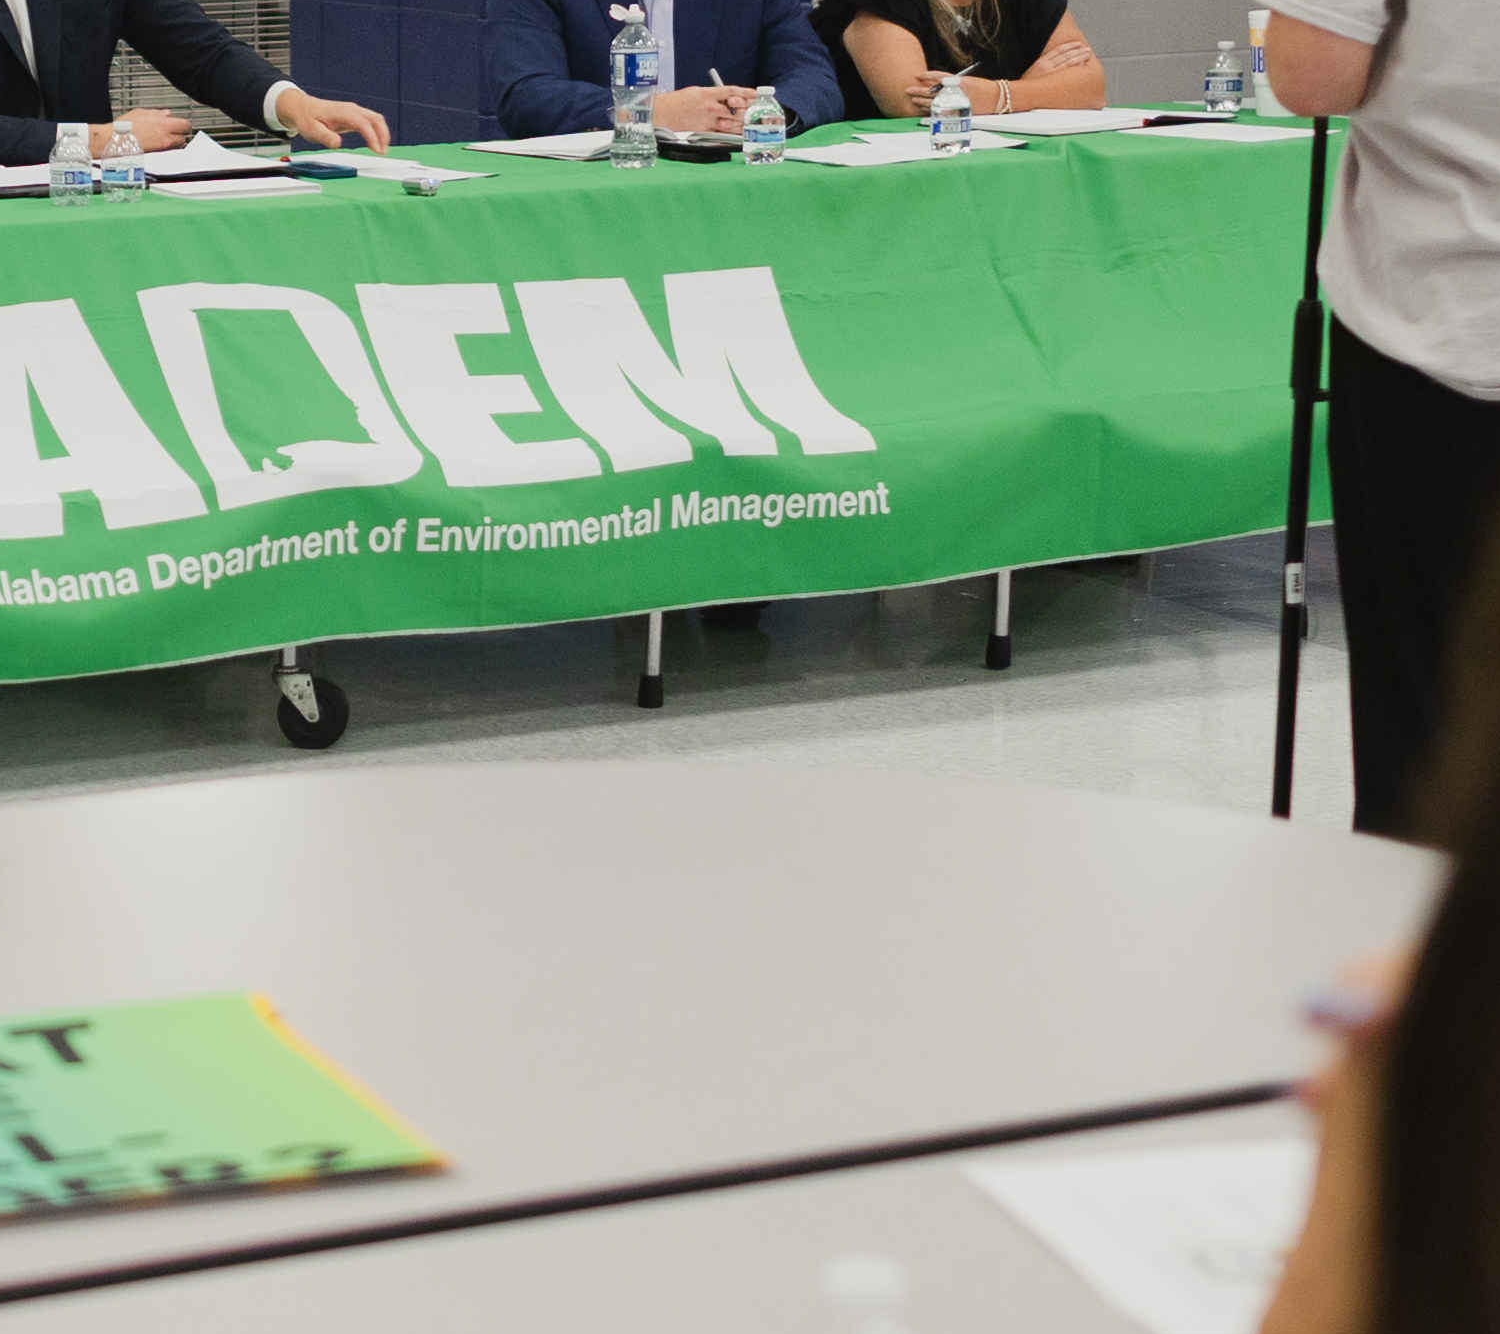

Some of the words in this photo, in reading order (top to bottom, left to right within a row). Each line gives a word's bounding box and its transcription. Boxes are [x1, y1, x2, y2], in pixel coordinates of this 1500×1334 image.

[147, 519, 360, 591] Department
[367, 515, 406, 555] of
[414, 496, 663, 555] Environmental
[669, 480, 891, 531] Management
